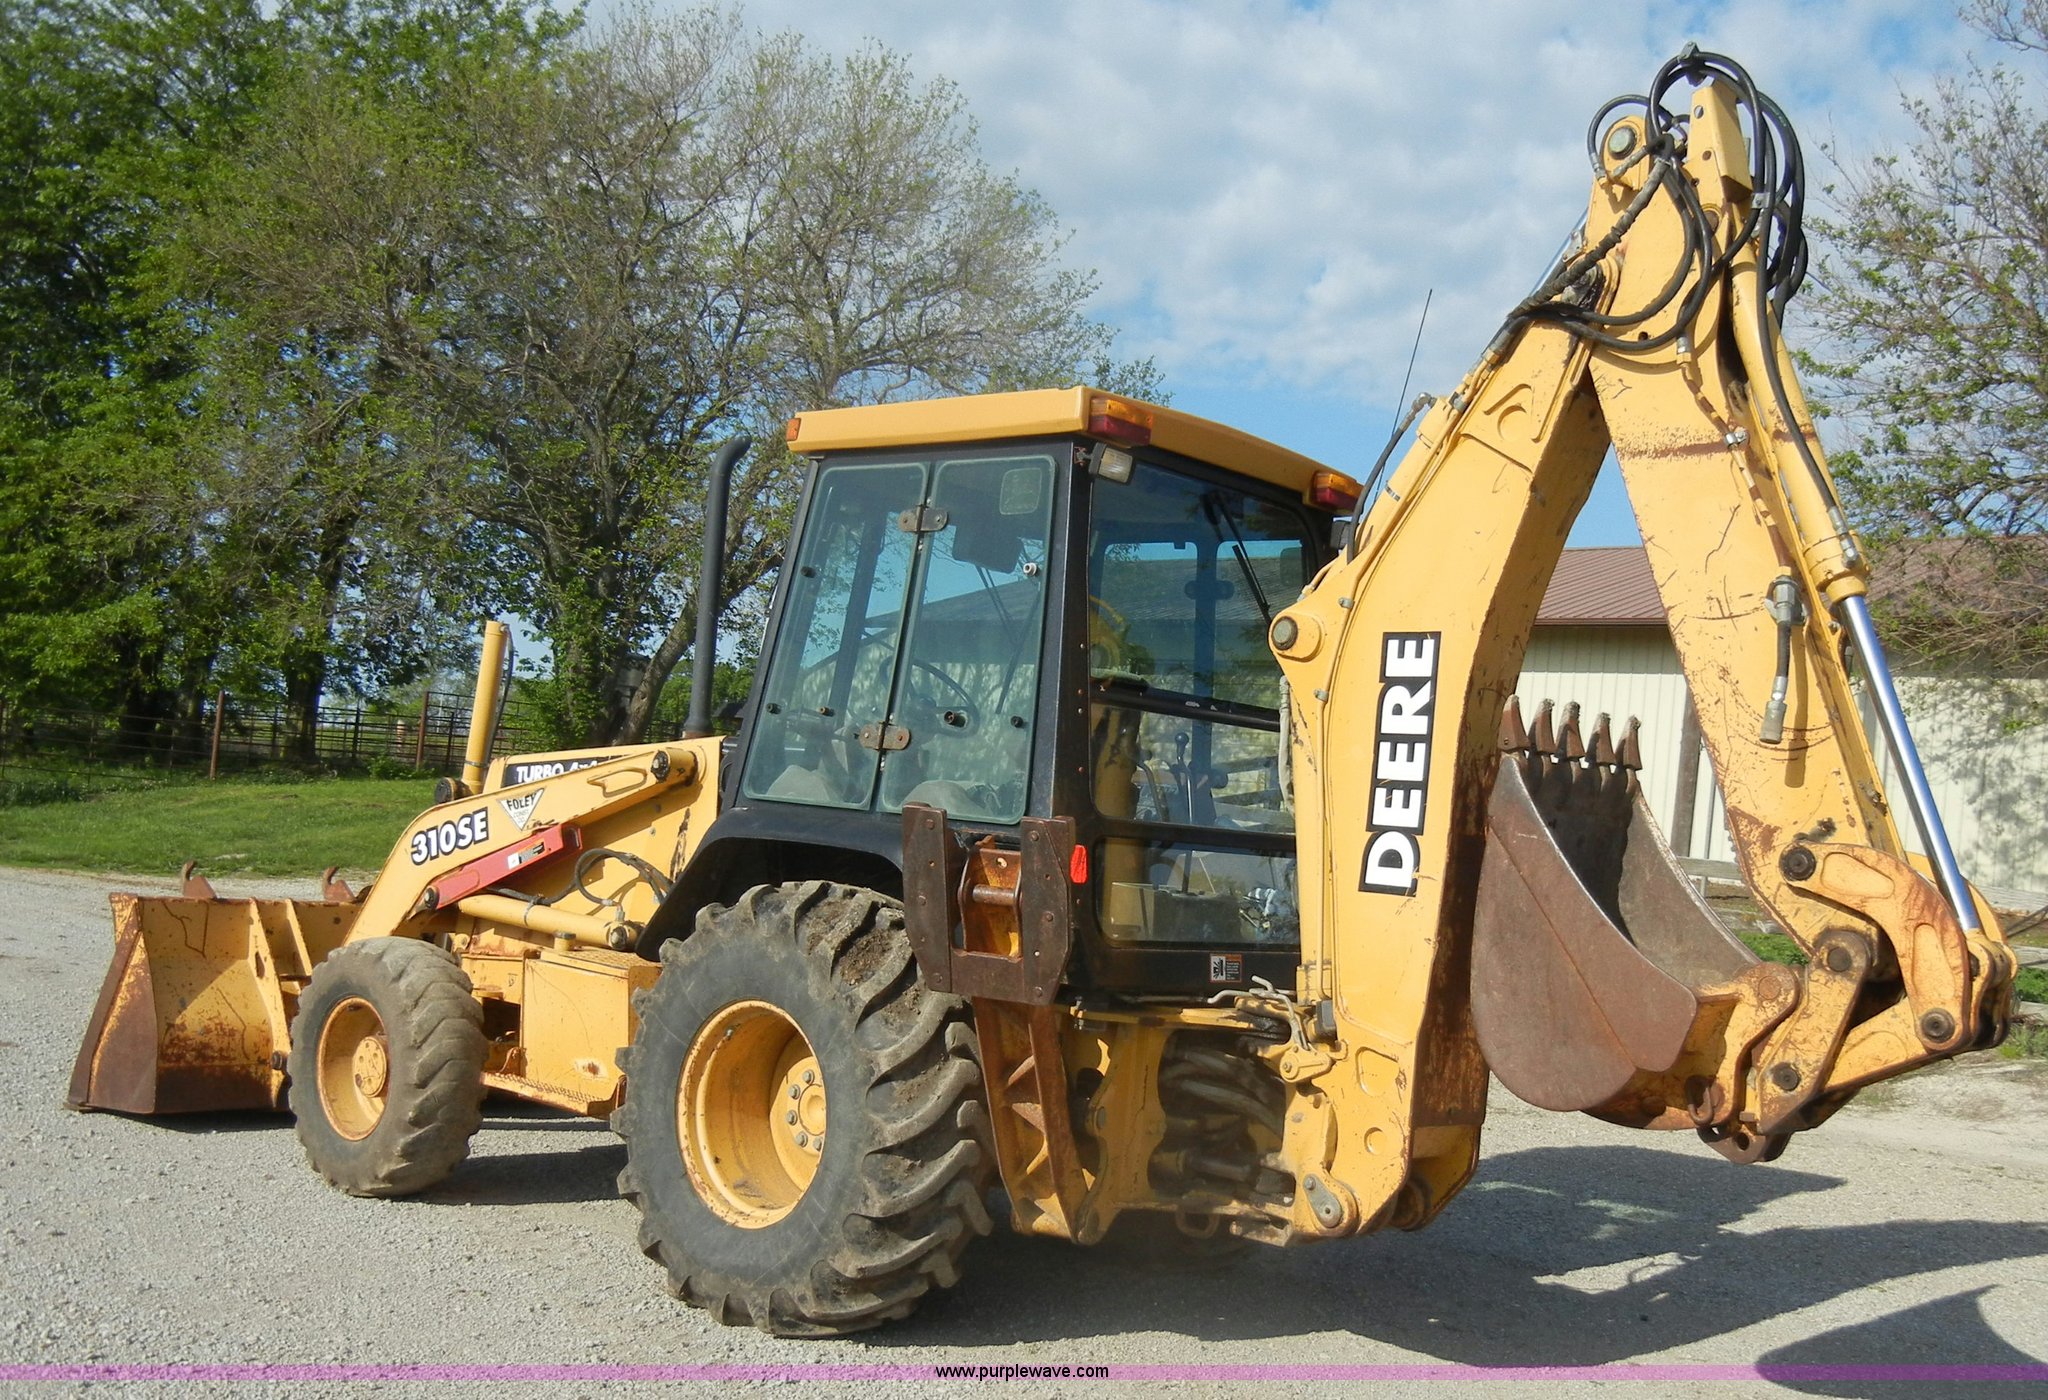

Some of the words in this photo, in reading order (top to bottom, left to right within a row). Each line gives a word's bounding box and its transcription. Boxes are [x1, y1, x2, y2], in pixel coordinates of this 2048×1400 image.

[516, 763, 564, 783] TURBO
[1362, 636, 1438, 892] DEERE
[506, 792, 537, 810] FOLEY
[411, 807, 489, 865] 310SE
